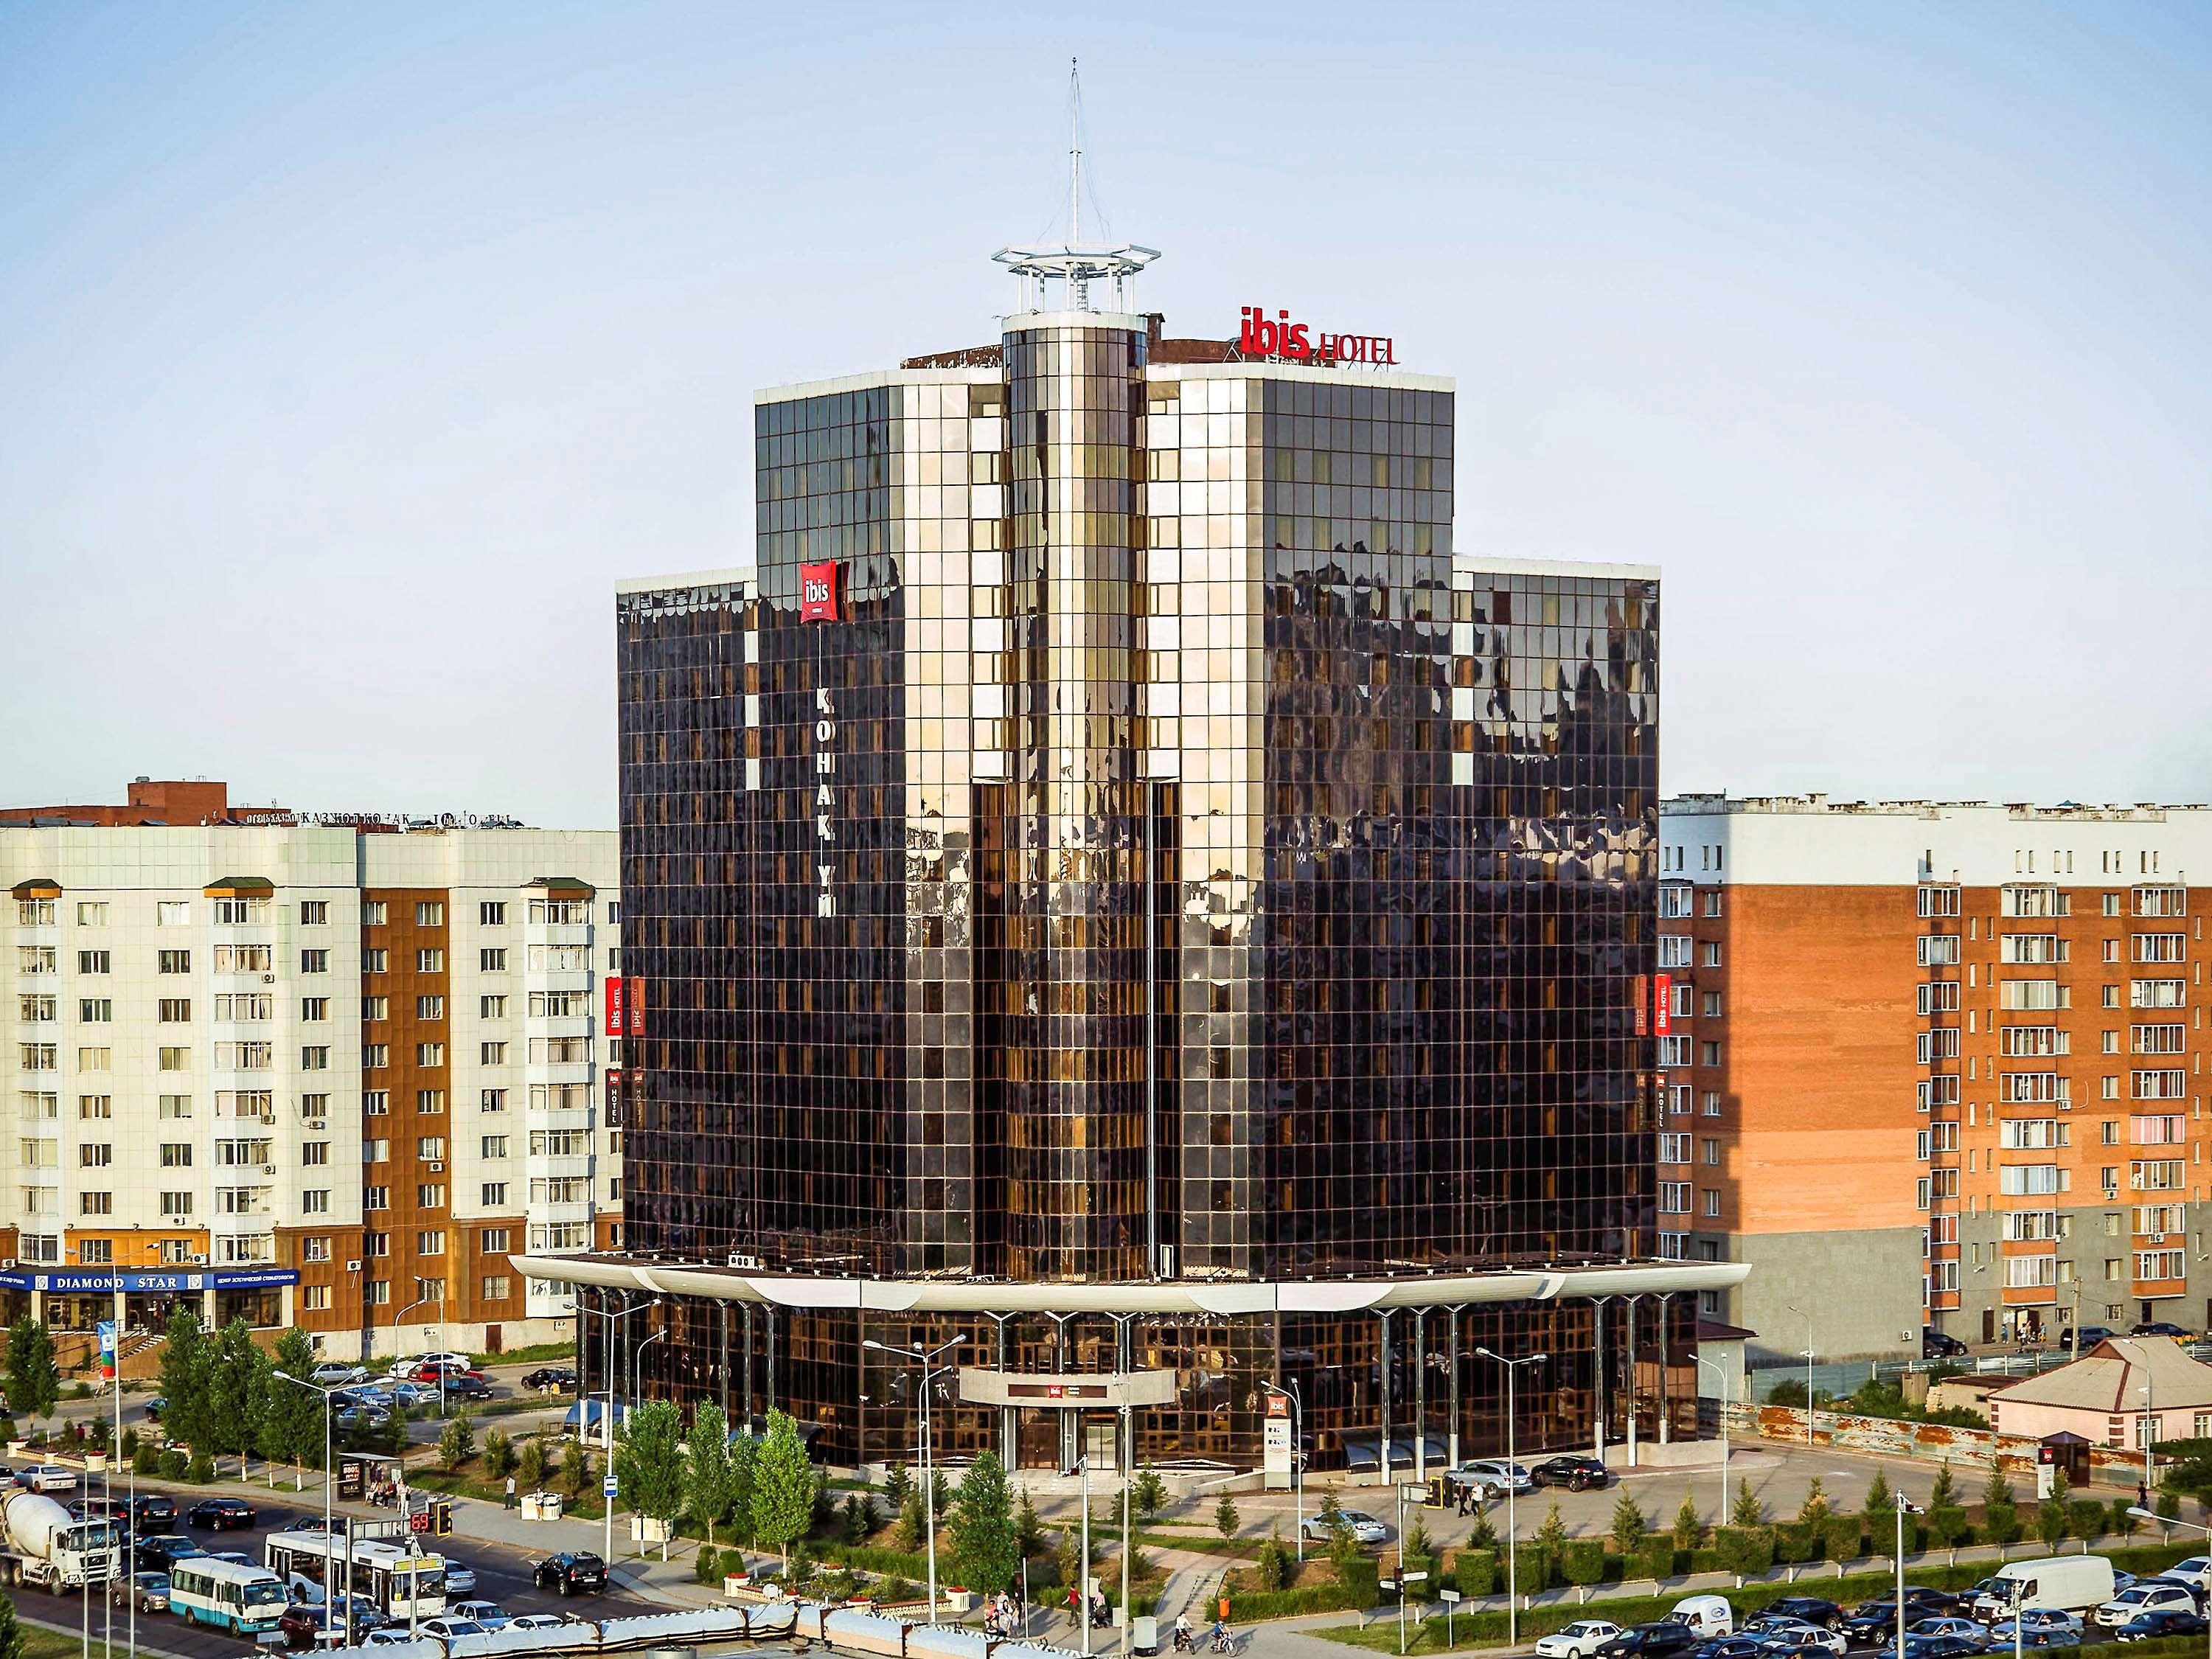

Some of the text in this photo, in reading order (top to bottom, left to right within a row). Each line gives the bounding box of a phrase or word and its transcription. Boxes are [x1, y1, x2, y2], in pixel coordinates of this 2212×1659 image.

[1240, 306, 1400, 364] ibis HOTEL
[805, 579, 829, 603] ibis
[611, 1010, 620, 1028] ibis
[1658, 1009, 1666, 1027] ibis
[57, 1278, 177, 1288] DIAMOND STAR
[1271, 1402, 1285, 1410] ibis
[412, 1514, 428, 1530] 69
